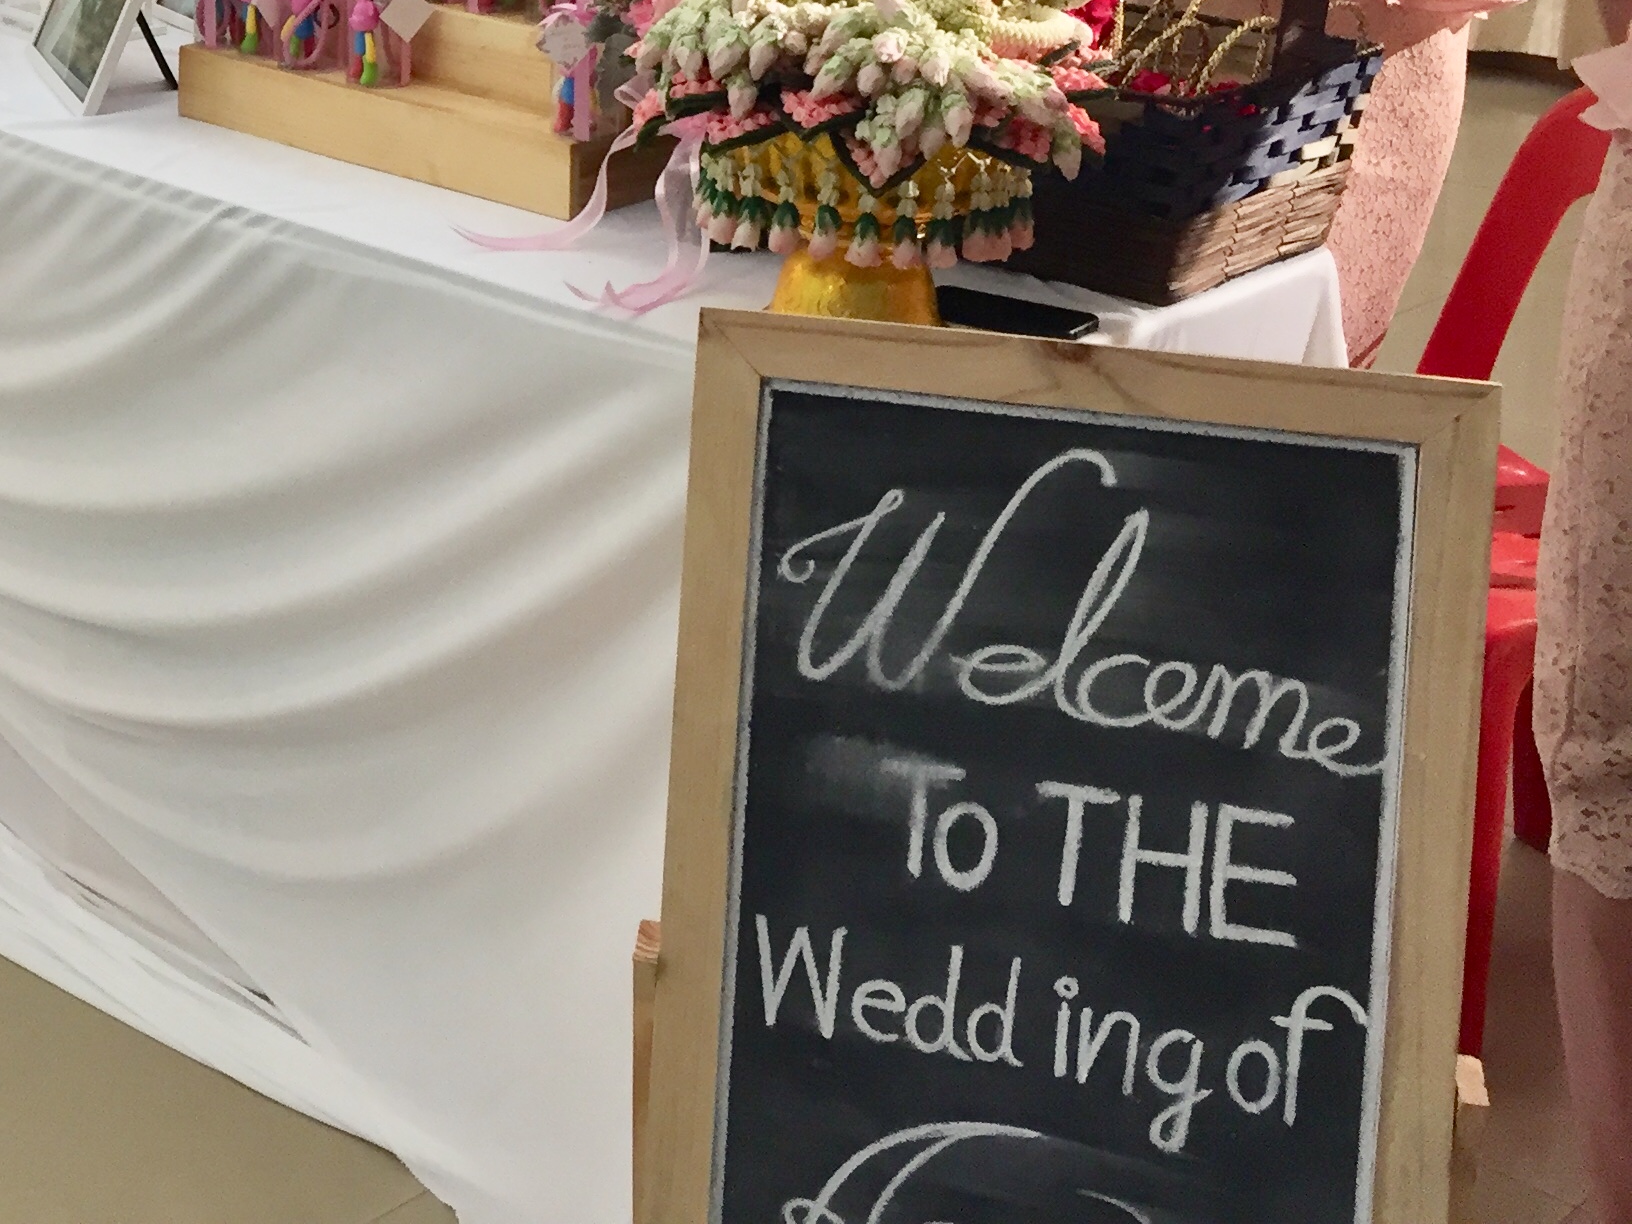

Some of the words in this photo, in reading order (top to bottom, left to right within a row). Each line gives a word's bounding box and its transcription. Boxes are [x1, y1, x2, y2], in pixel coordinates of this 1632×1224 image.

[776, 449, 1388, 776] Welcome
[1037, 780, 1298, 947] THE
[1226, 984, 1367, 1126] of
